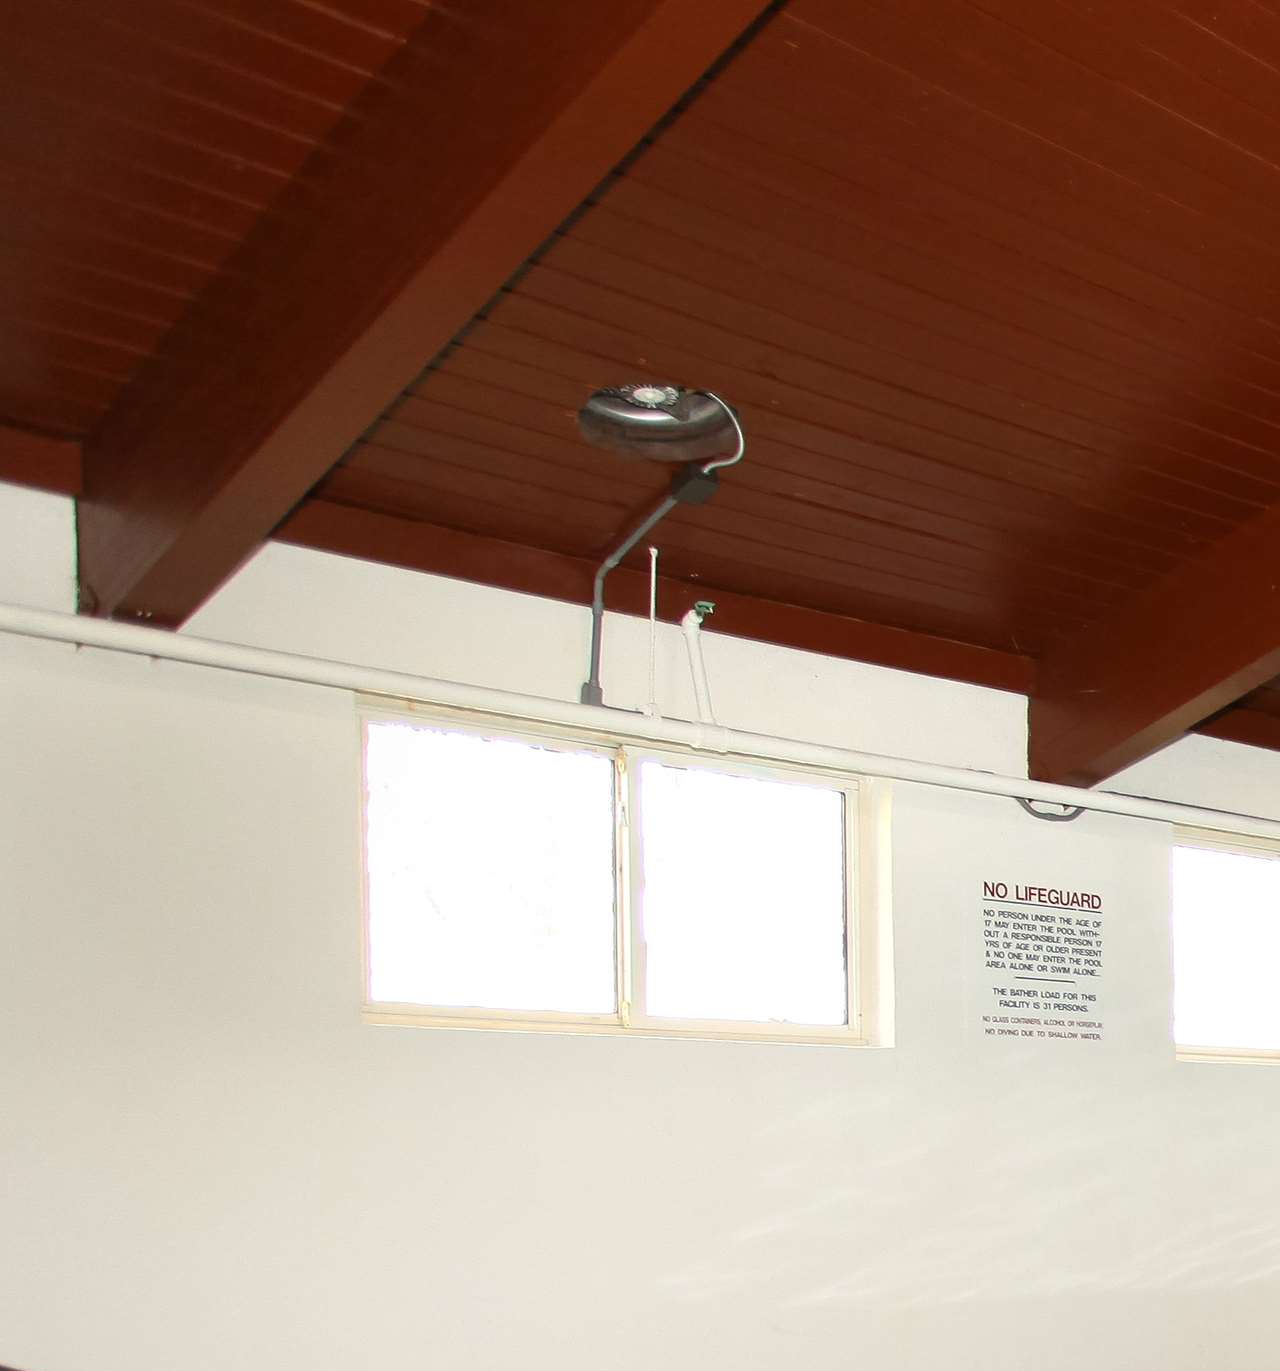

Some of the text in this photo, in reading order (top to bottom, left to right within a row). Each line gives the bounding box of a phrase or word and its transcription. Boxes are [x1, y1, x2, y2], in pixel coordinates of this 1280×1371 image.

[983, 881, 1101, 909] NO LIFEGUARD
[983, 909, 995, 917] NO
[998, 910, 1029, 921] PERSON
[1031, 914, 1056, 923] UNDER
[1059, 917, 1072, 926] THE
[1075, 919, 1089, 927] AGE
[995, 921, 1009, 929] MAY
[1013, 923, 1037, 932] ENTER
[1041, 925, 1054, 933] THE
[1056, 927, 1076, 936] POOL
[984, 930, 999, 938] OUT
[1011, 932, 1061, 943] RESPONSIBLE
[1064, 937, 1092, 946] PERSON
[1015, 943, 1029, 951] AGE
[1046, 946, 1069, 954] OLDER
[1072, 948, 1102, 957] PRESENT
[994, 951, 1005, 959] NO
[1007, 952, 1023, 960] ONE
[1043, 955, 1066, 964] ENTER
[1084, 958, 1103, 967] POOL
[985, 961, 1006, 969] AREA
[1009, 962, 1034, 971] ALONE
[1051, 966, 1070, 974] SWIM
[992, 988, 1096, 1001] THE BATHER LOAD FOR THIS
[999, 1000, 1030, 1009] FACILITY
[998, 1029, 1019, 1037] DIVING
